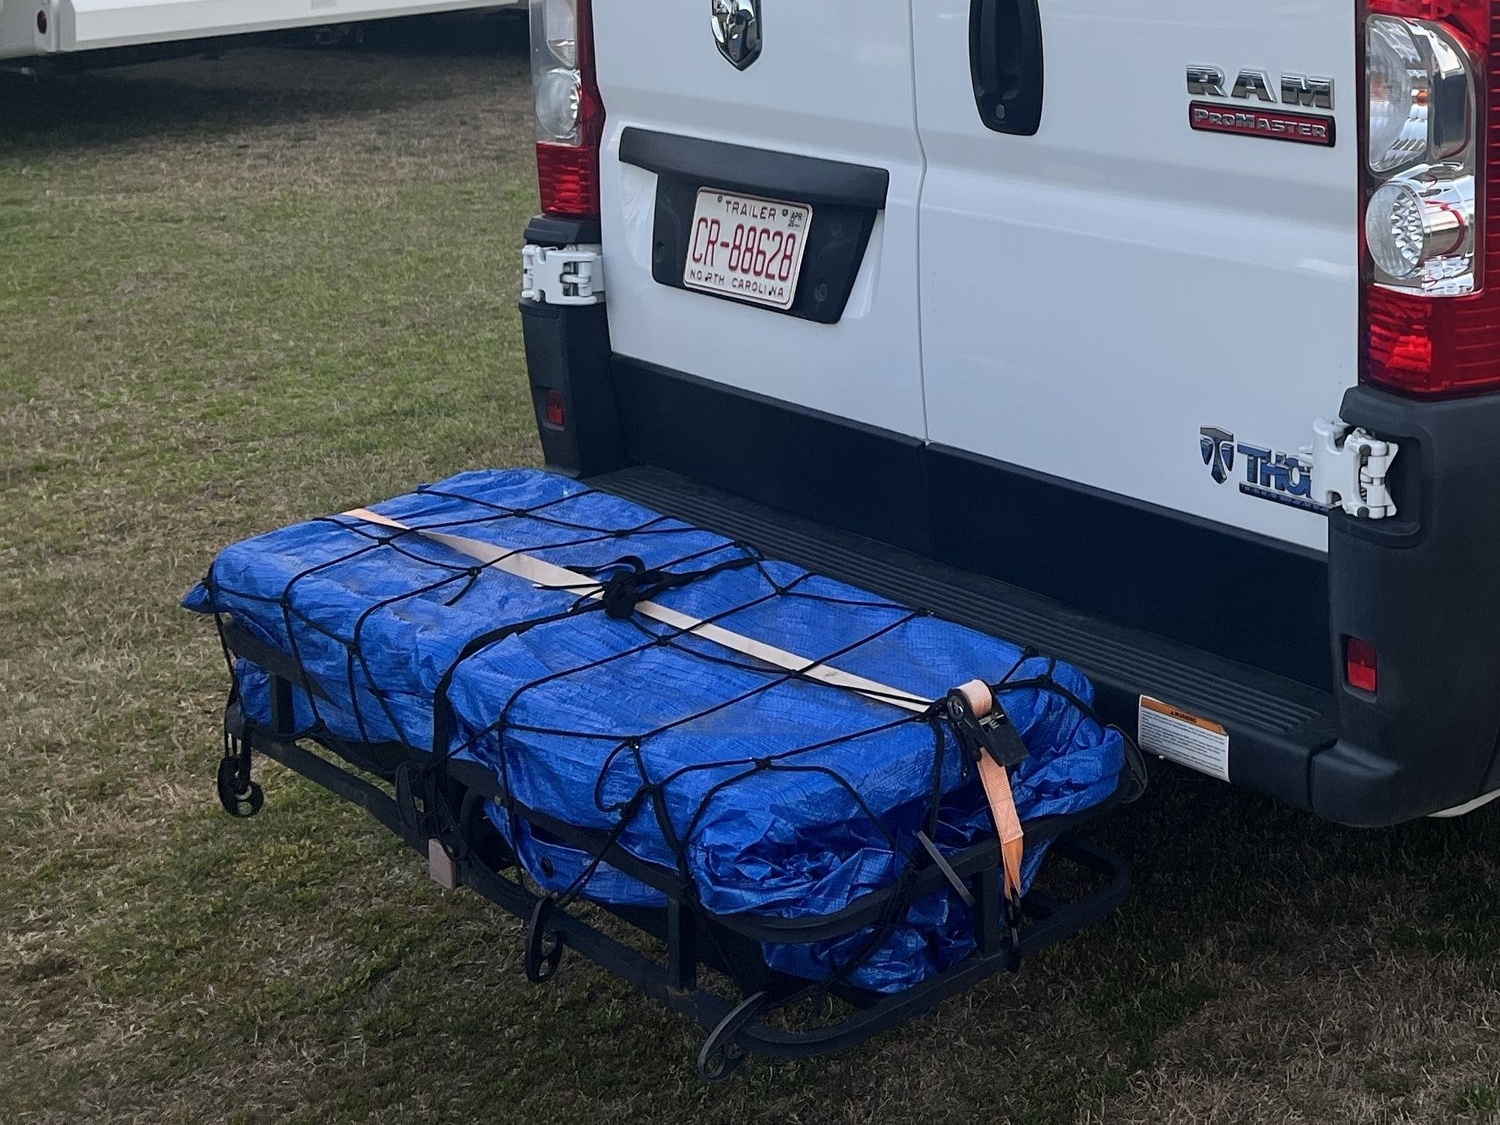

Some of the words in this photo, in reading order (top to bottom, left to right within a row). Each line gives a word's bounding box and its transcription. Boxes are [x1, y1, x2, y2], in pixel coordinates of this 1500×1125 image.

[1186, 64, 1335, 110] RAM
[725, 200, 777, 221] TRAILER
[692, 216, 796, 283] CR-88628
[690, 269, 725, 285] NORTH
[731, 278, 784, 297] CAROLINA
[1236, 440, 1314, 499] THO
